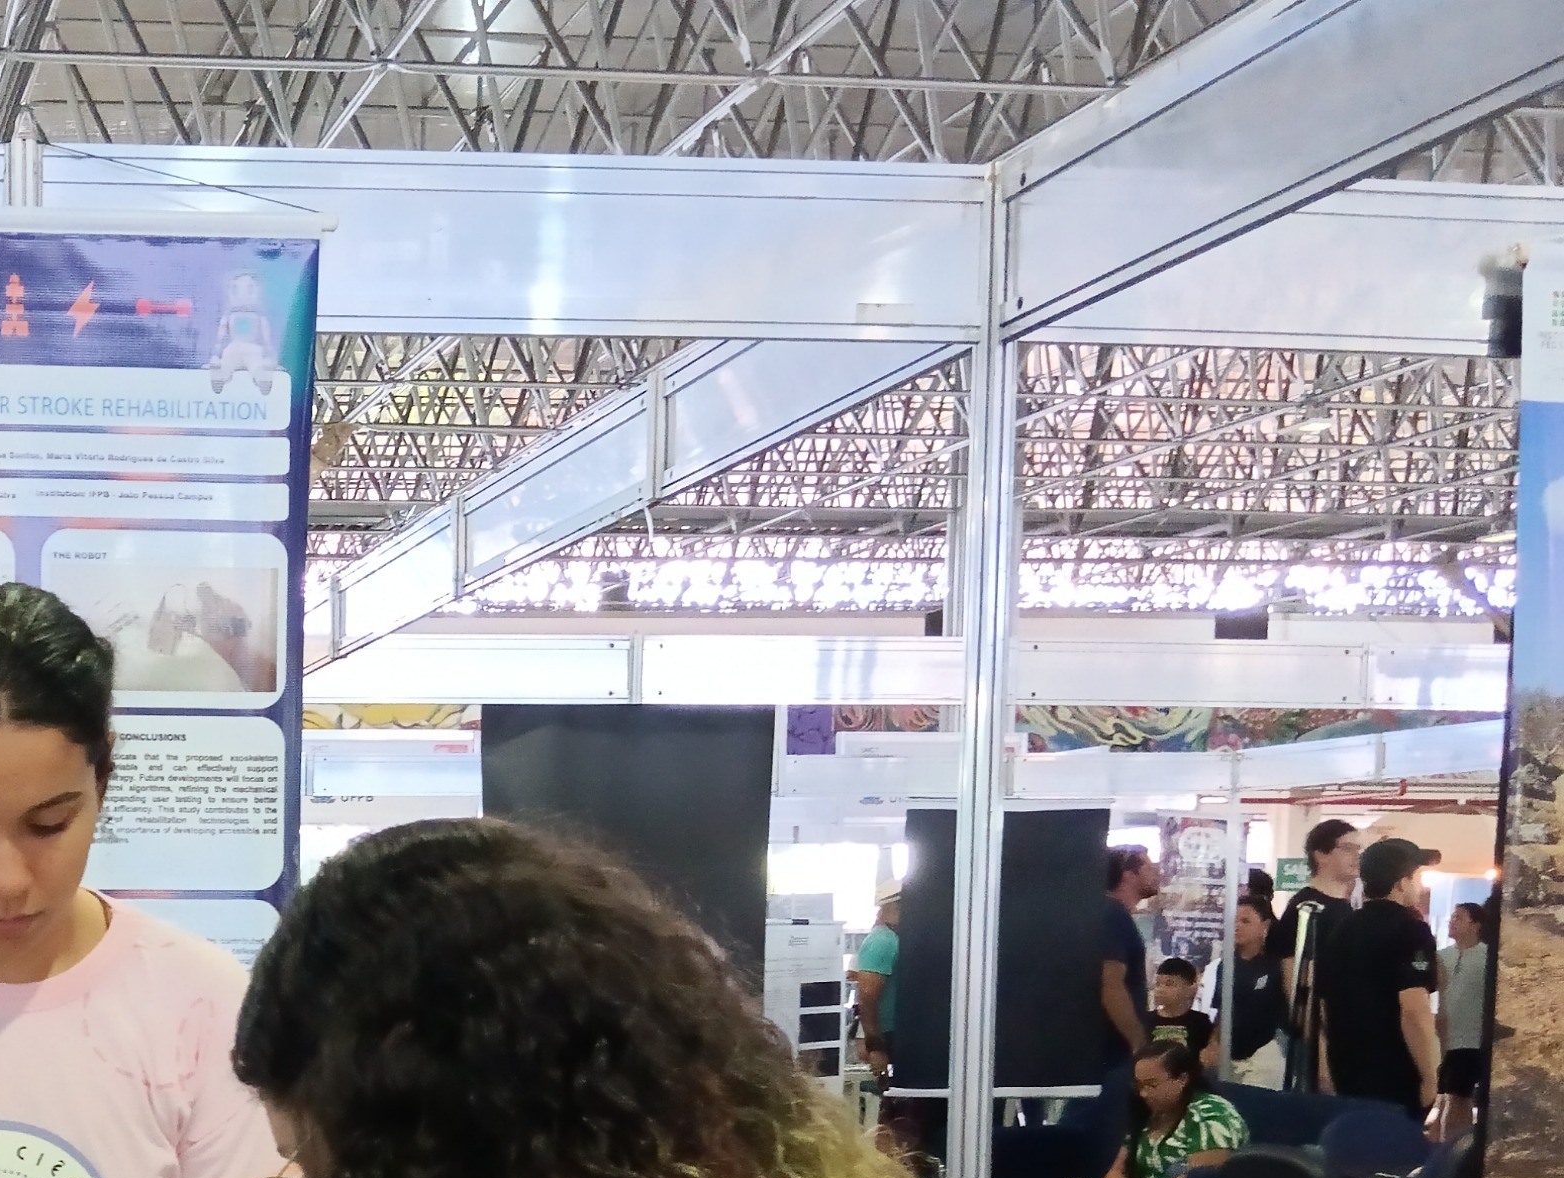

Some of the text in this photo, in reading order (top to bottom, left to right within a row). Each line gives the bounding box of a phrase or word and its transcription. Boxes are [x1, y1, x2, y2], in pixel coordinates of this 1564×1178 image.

[18, 396, 94, 416] STROKE
[102, 399, 266, 420] REHABILITATION
[53, 552, 107, 560] THE ROBOT
